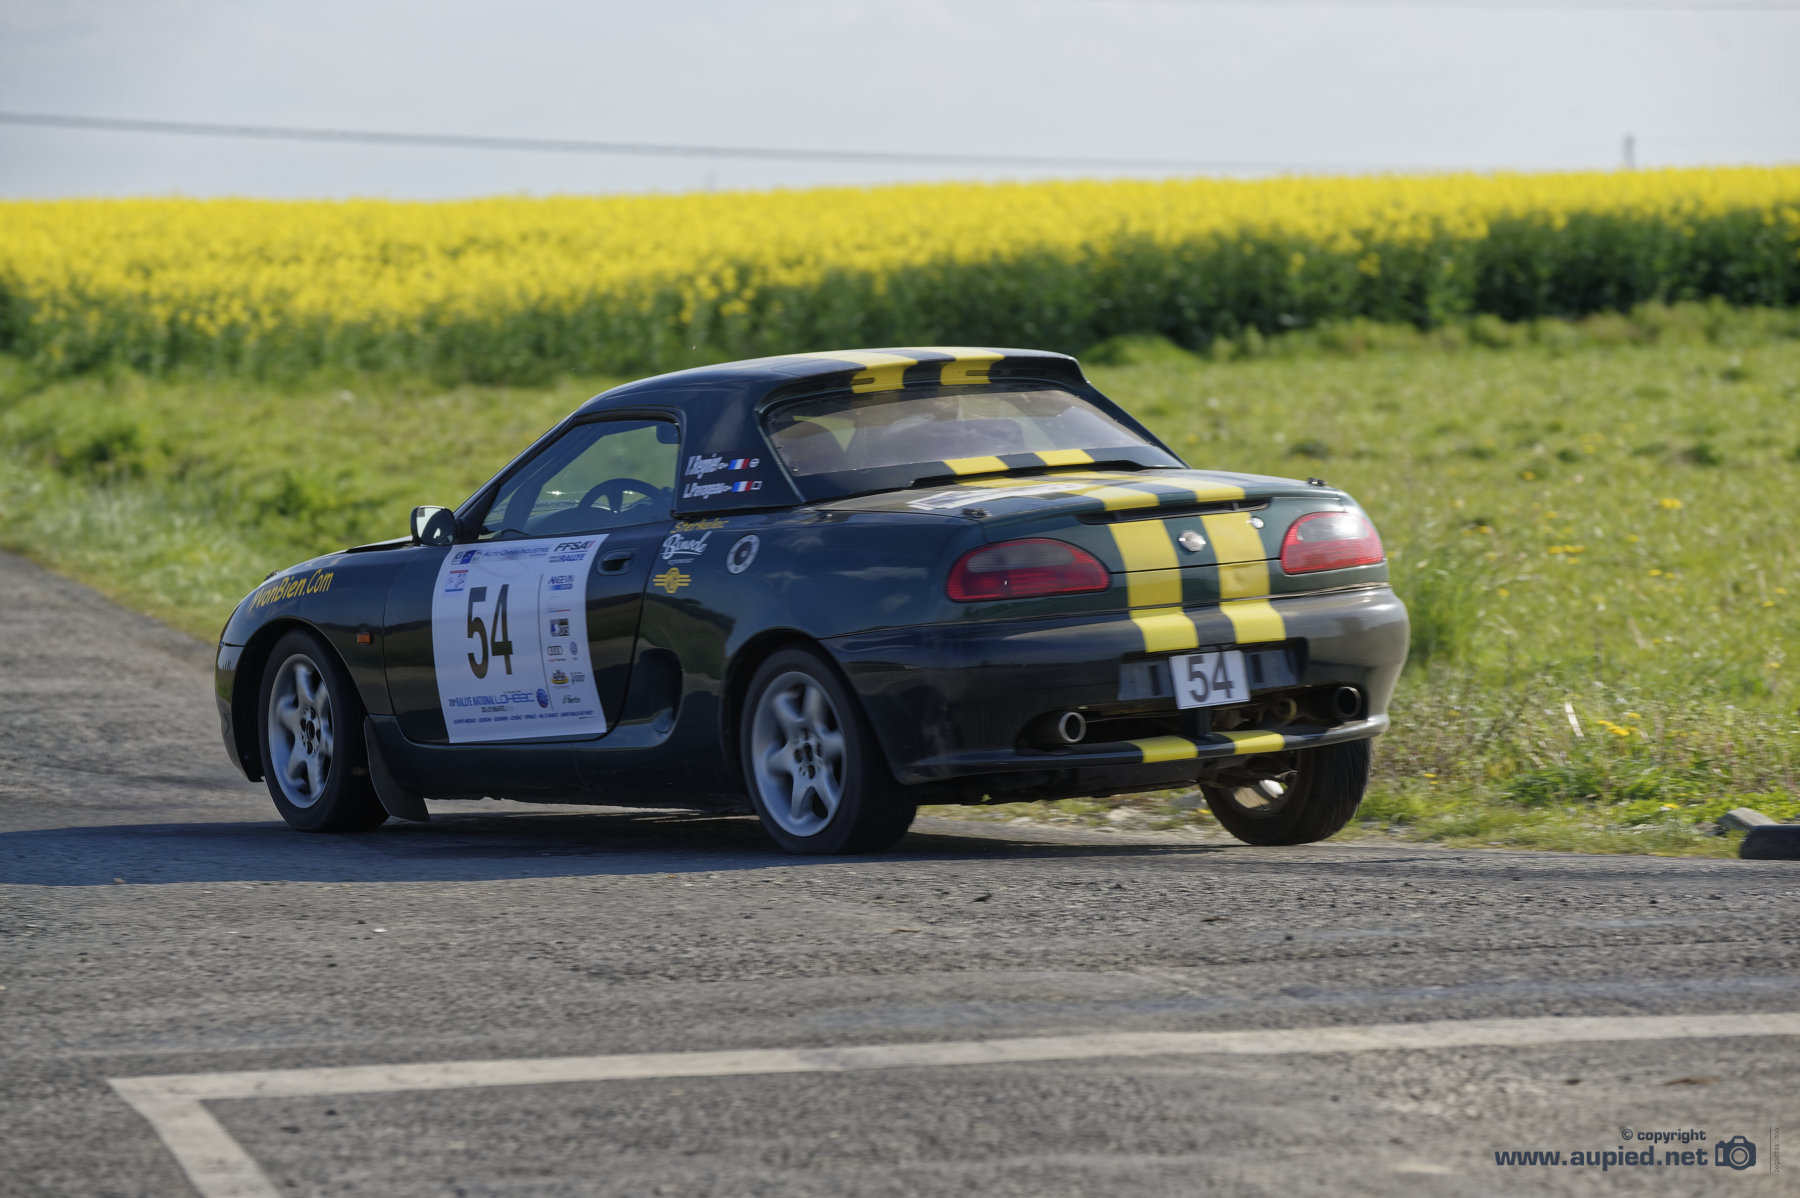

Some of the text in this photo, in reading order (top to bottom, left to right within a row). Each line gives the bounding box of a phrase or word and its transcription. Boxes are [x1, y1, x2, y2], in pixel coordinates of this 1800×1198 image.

[555, 541, 590, 551] FFSA
[467, 584, 513, 679] 54
[1187, 651, 1235, 702] 54
